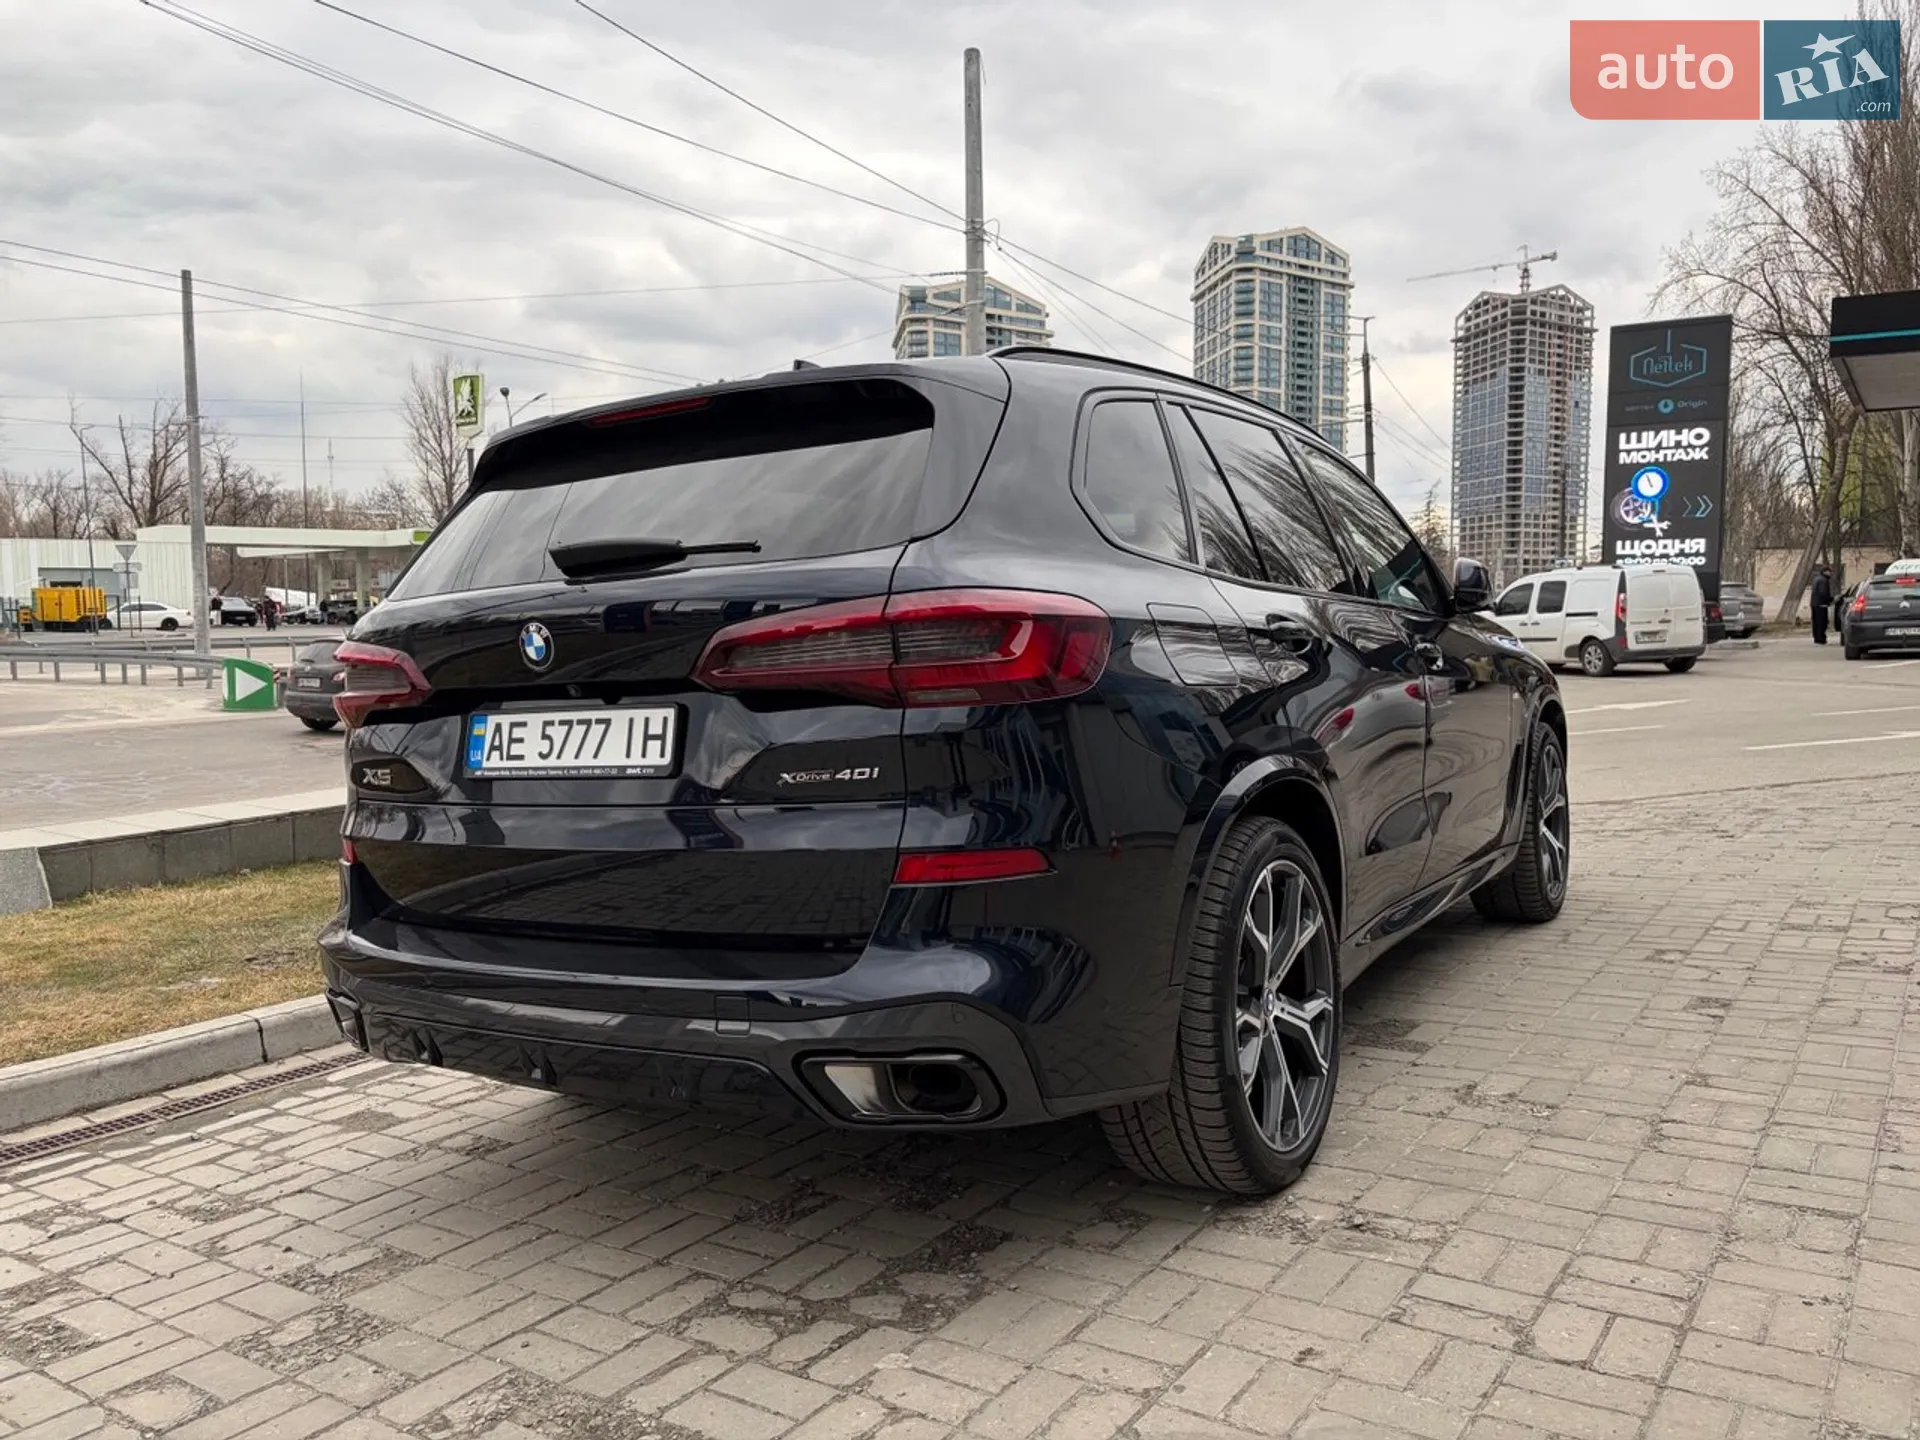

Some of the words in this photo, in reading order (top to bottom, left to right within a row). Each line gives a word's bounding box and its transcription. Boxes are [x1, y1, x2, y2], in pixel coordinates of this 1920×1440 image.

[1618, 427, 1711, 450] ШИНО
[1618, 446, 1709, 464] МОНТАЖ
[1615, 538, 1707, 556] ЩОДНЯ
[485, 721, 528, 762] AE
[537, 718, 612, 761] 5777
[624, 715, 669, 759] IH
[362, 767, 391, 785] X5
